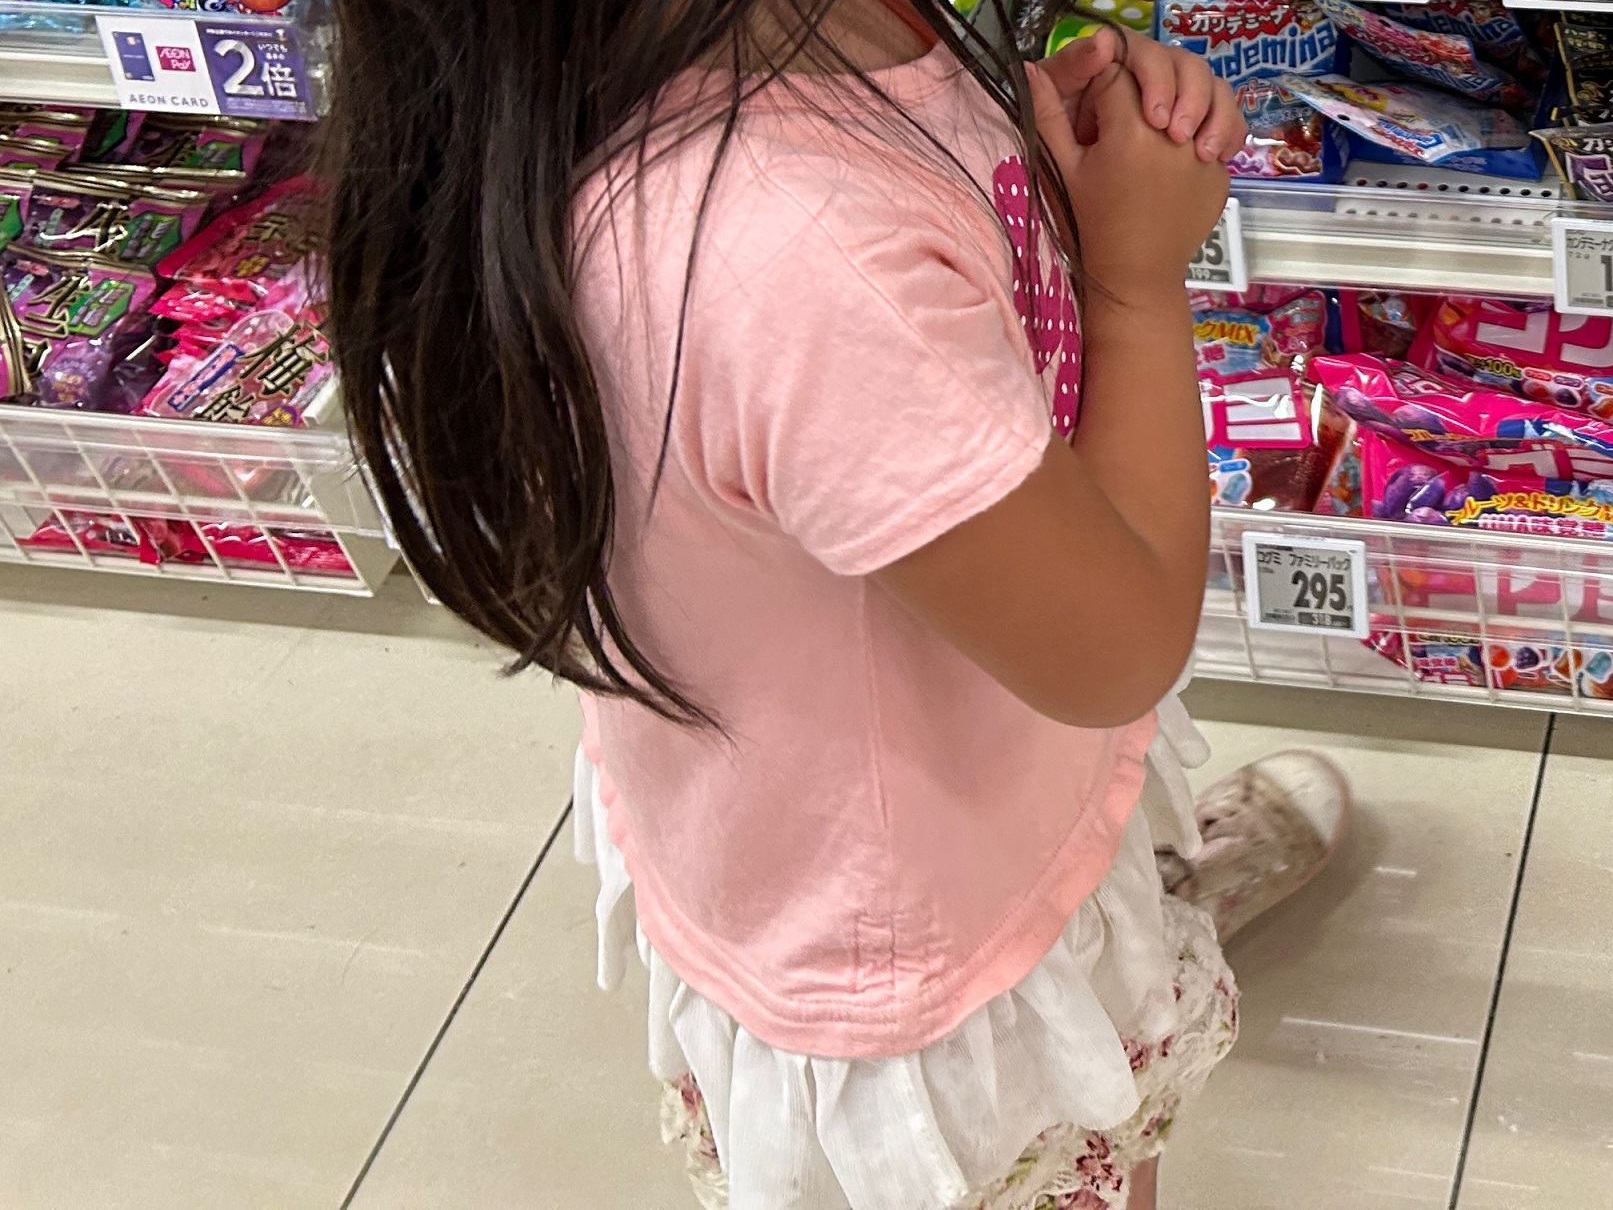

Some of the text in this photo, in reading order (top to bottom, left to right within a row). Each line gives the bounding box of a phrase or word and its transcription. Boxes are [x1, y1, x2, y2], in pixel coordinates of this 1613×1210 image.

[129, 94, 209, 108] AEON CARD
[1291, 570, 1347, 611] 295
